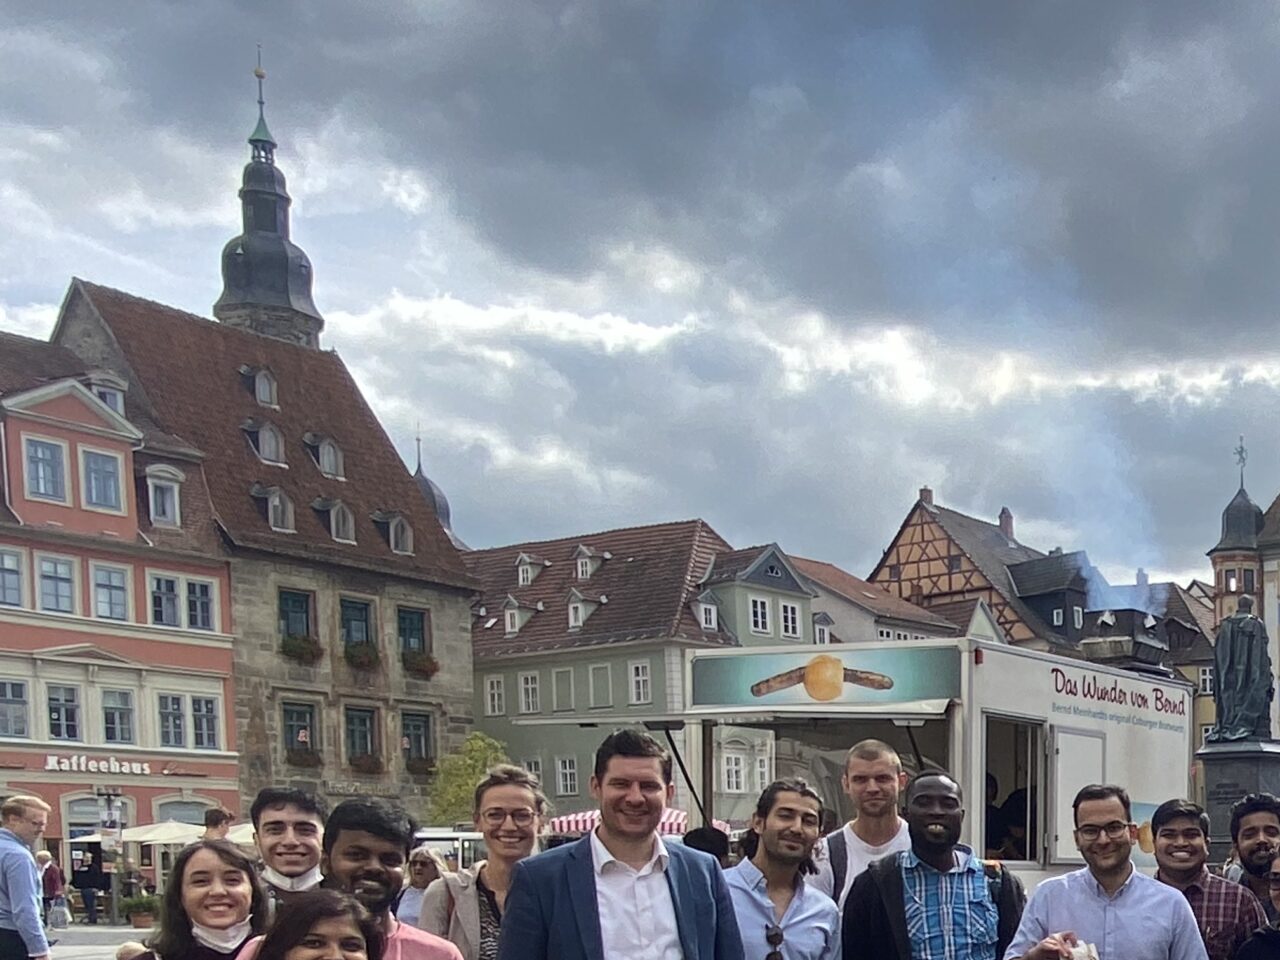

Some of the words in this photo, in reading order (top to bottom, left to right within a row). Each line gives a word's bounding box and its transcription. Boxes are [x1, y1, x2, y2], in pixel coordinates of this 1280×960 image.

[1051, 667, 1078, 697] Das
[1082, 675, 1128, 706] Wunder
[1130, 690, 1149, 709] von
[1152, 687, 1186, 716] Bernd
[1052, 702, 1071, 714] Bernd
[45, 755, 151, 775] Kaffeehaus
